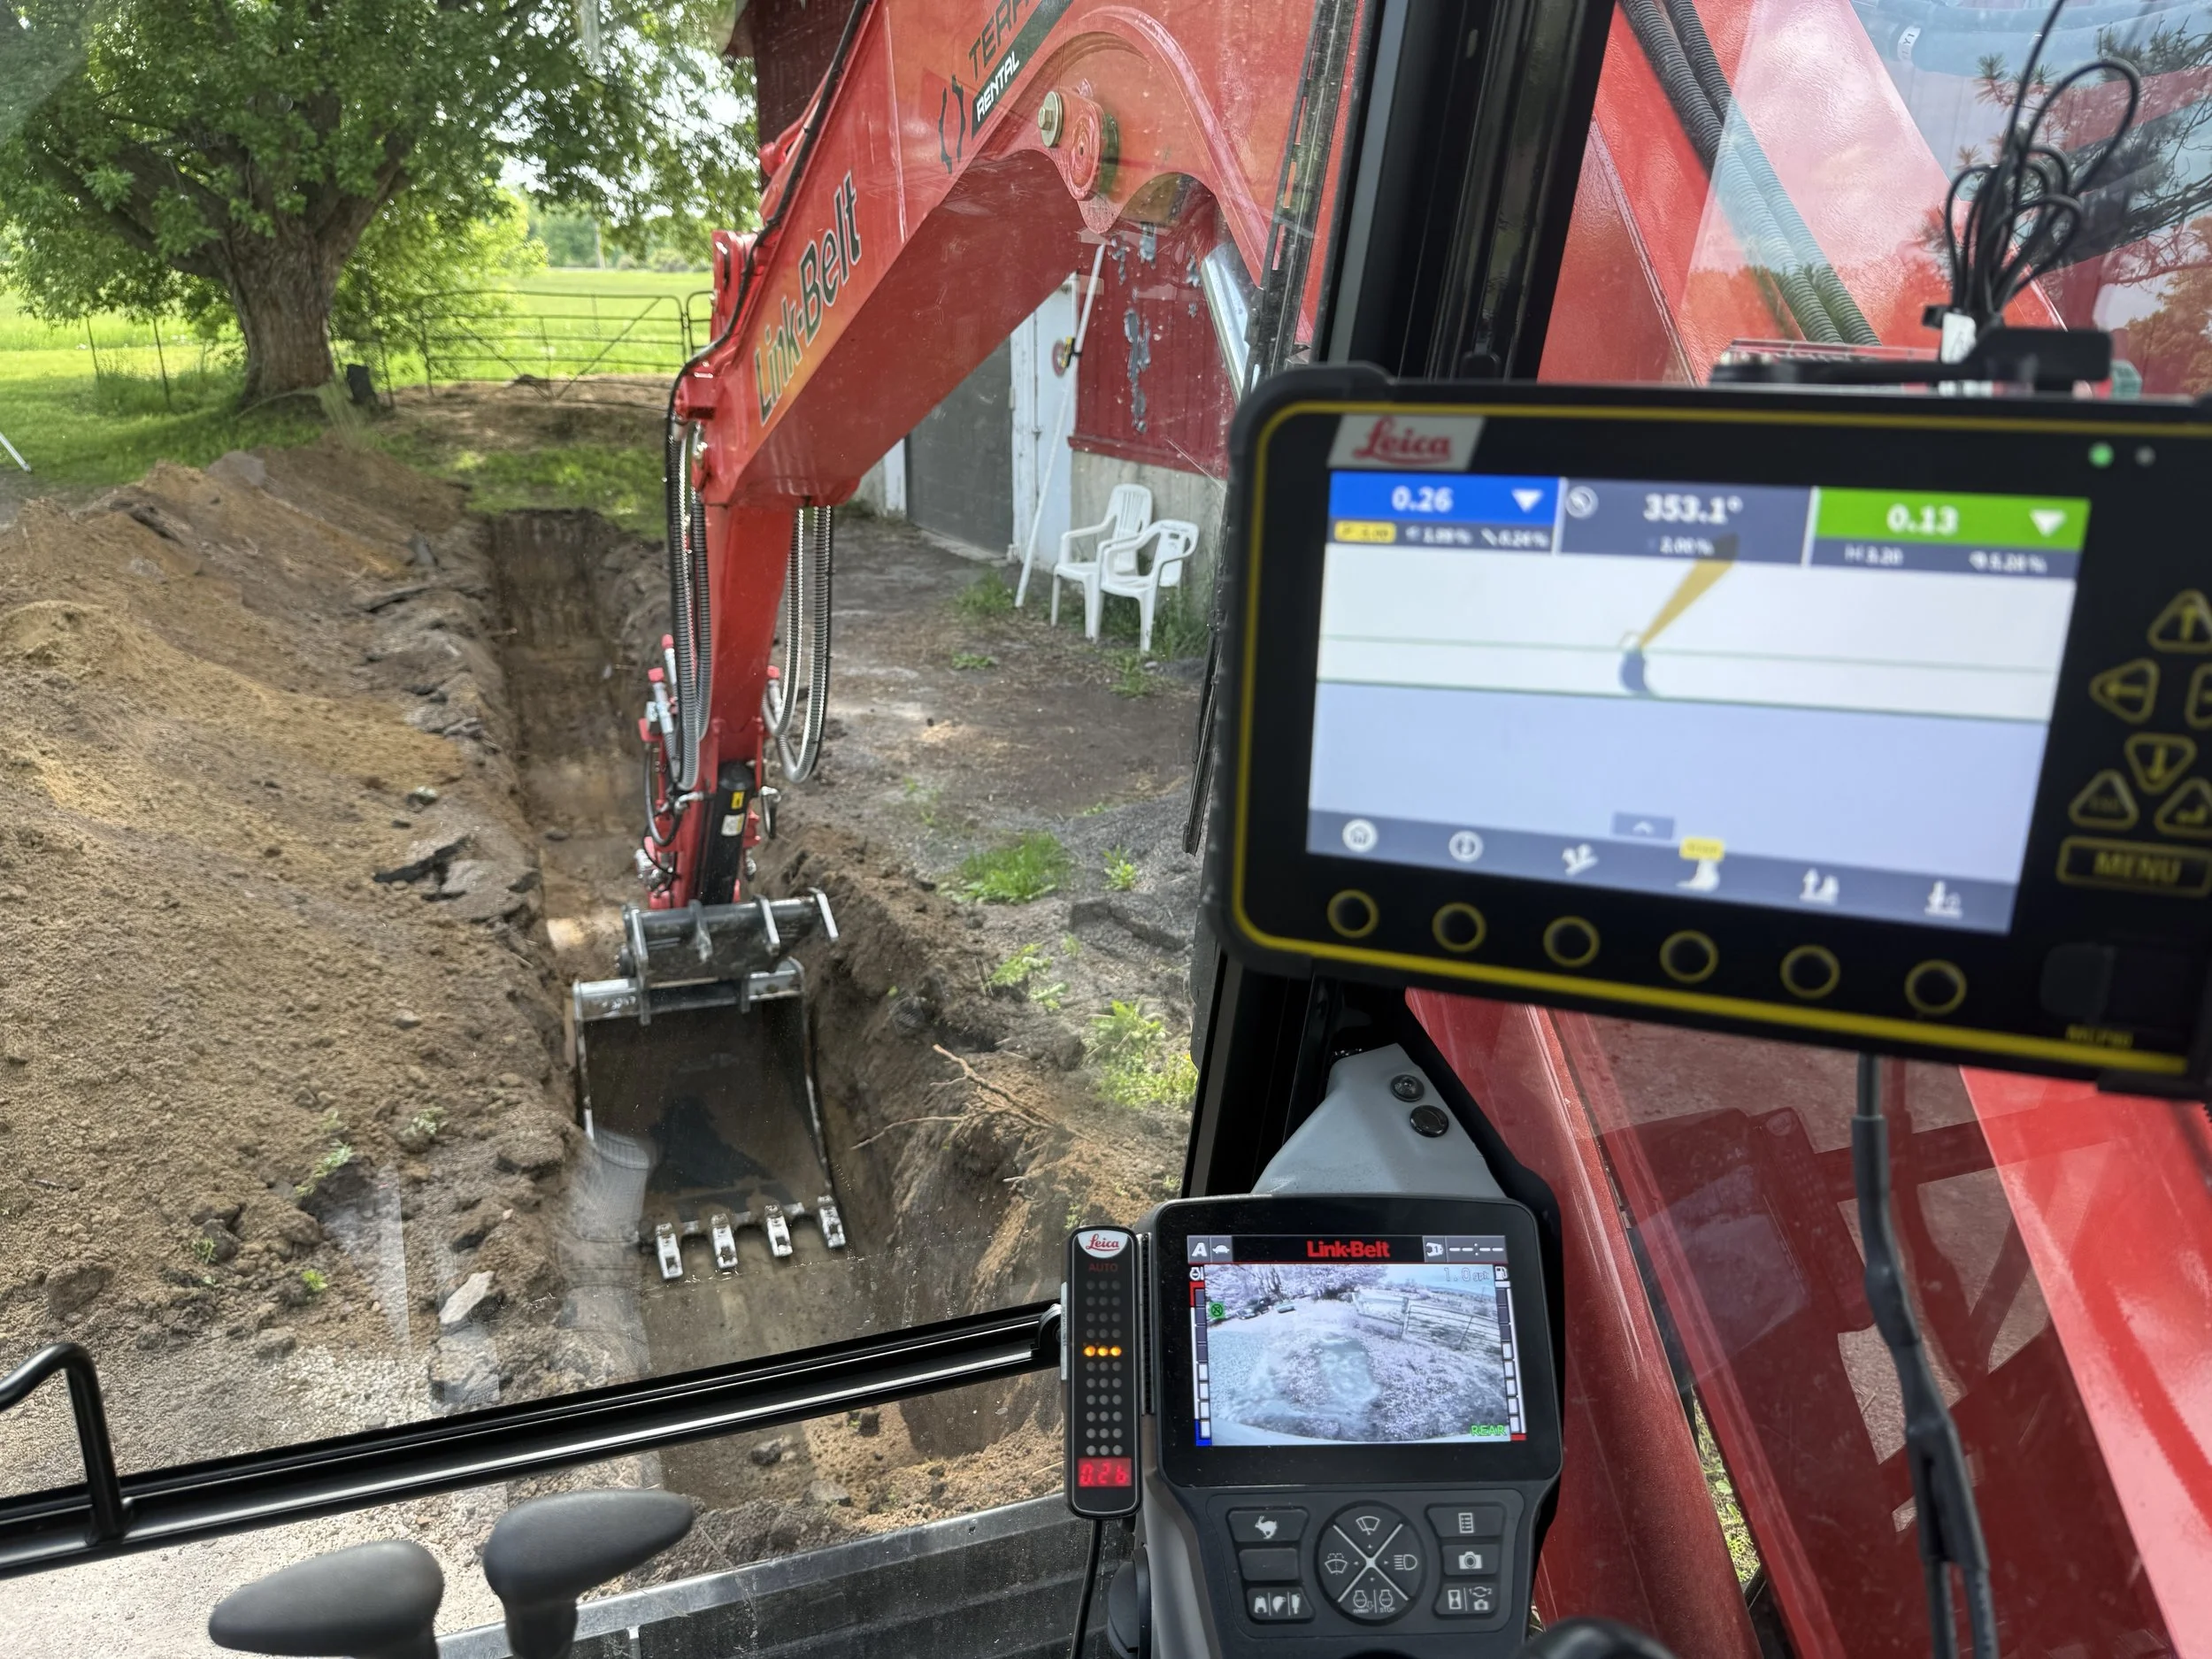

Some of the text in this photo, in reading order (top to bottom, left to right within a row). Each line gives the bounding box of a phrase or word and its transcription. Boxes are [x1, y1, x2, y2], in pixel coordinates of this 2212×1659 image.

[976, 50, 1019, 122] RENTAL
[754, 169, 862, 426] Link-Belt
[1352, 414, 1454, 465] Leica
[1392, 486, 1453, 512] 0.26
[1886, 503, 1959, 536] 0.13
[2093, 851, 2182, 883] MENU
[1086, 1233, 1119, 1251] Leica
[1192, 1242, 1208, 1257] A
[1307, 1240, 1390, 1258] Link-Belt
[1089, 1263, 1118, 1271] AUTO
[1444, 1267, 1471, 1282] 1.0
[1471, 1425, 1507, 1436] REAR
